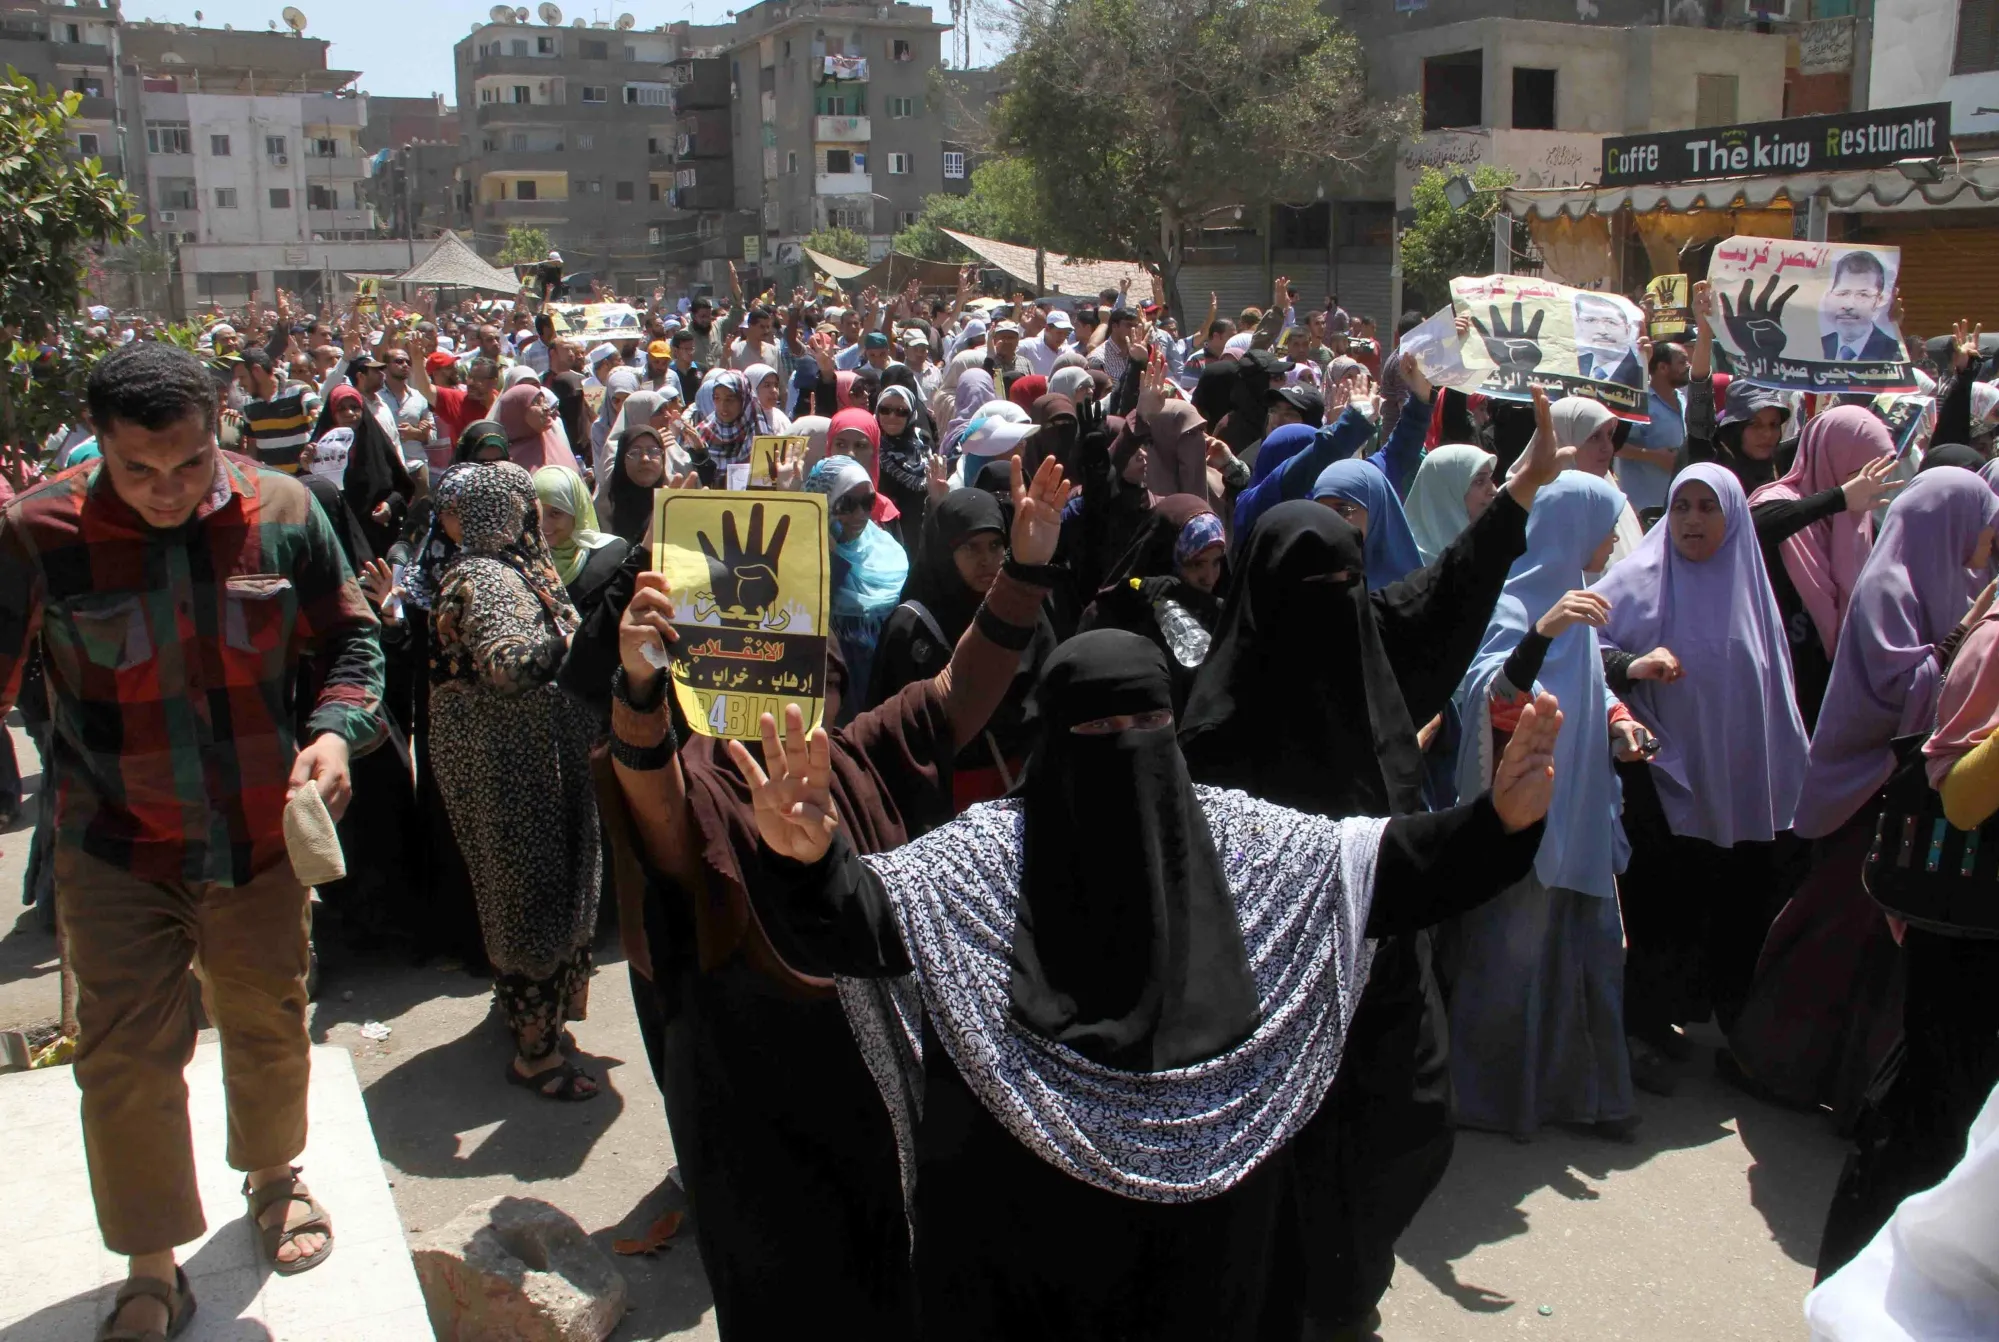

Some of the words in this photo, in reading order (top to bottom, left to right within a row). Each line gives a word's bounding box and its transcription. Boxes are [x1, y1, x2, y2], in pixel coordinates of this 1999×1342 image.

[1608, 144, 1659, 174] Coffe
[1718, 240, 1773, 272] قريب
[1775, 247, 1830, 273] النصر
[1772, 361, 1809, 382] صمود
[1850, 363, 1905, 384] الشعب
[693, 592, 791, 631] رابعة
[688, 636, 785, 663] الانقلاب
[712, 666, 749, 688] خراب
[771, 671, 813, 695] إرهاب
